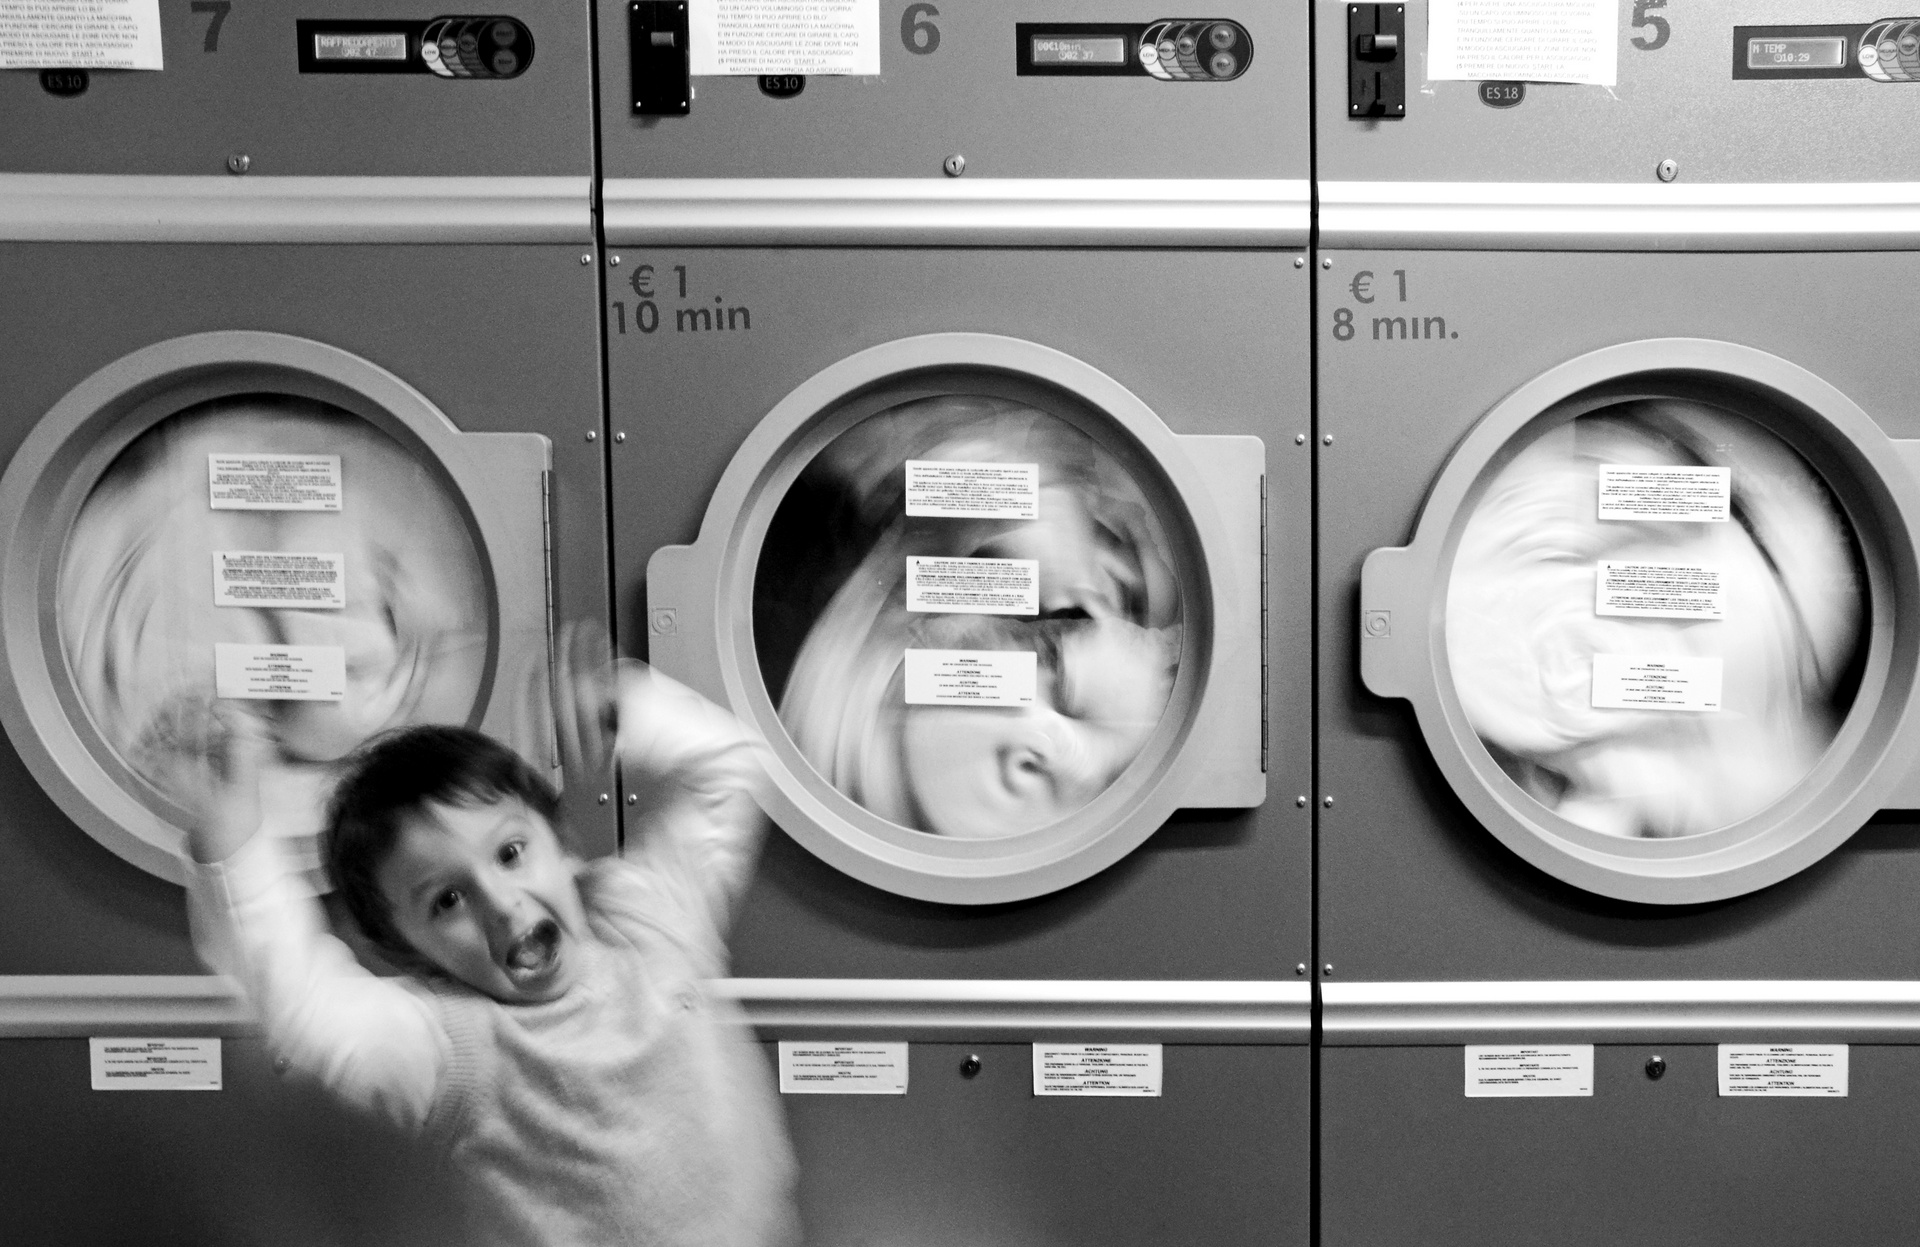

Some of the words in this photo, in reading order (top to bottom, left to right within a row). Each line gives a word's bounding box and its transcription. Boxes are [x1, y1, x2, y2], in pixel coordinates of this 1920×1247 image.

[190, 0, 231, 52] 7
[900, 2, 940, 54] 6
[1630, 0, 1670, 50] 5
[1752, 44, 1760, 53] M
[1764, 43, 1786, 53] TEMP
[48, 74, 62, 88] ES
[68, 75, 81, 88] 10
[766, 77, 780, 89] ES
[784, 76, 798, 89] 10
[1486, 87, 1500, 99] ES
[1504, 87, 1518, 99] 18
[629, 265, 654, 298] €
[674, 265, 686, 298] 1
[1349, 270, 1374, 304] €
[1393, 270, 1406, 302] 1
[612, 300, 659, 334] 10
[676, 296, 750, 332] min
[1332, 308, 1355, 341] 8
[1372, 316, 1458, 340] min.
